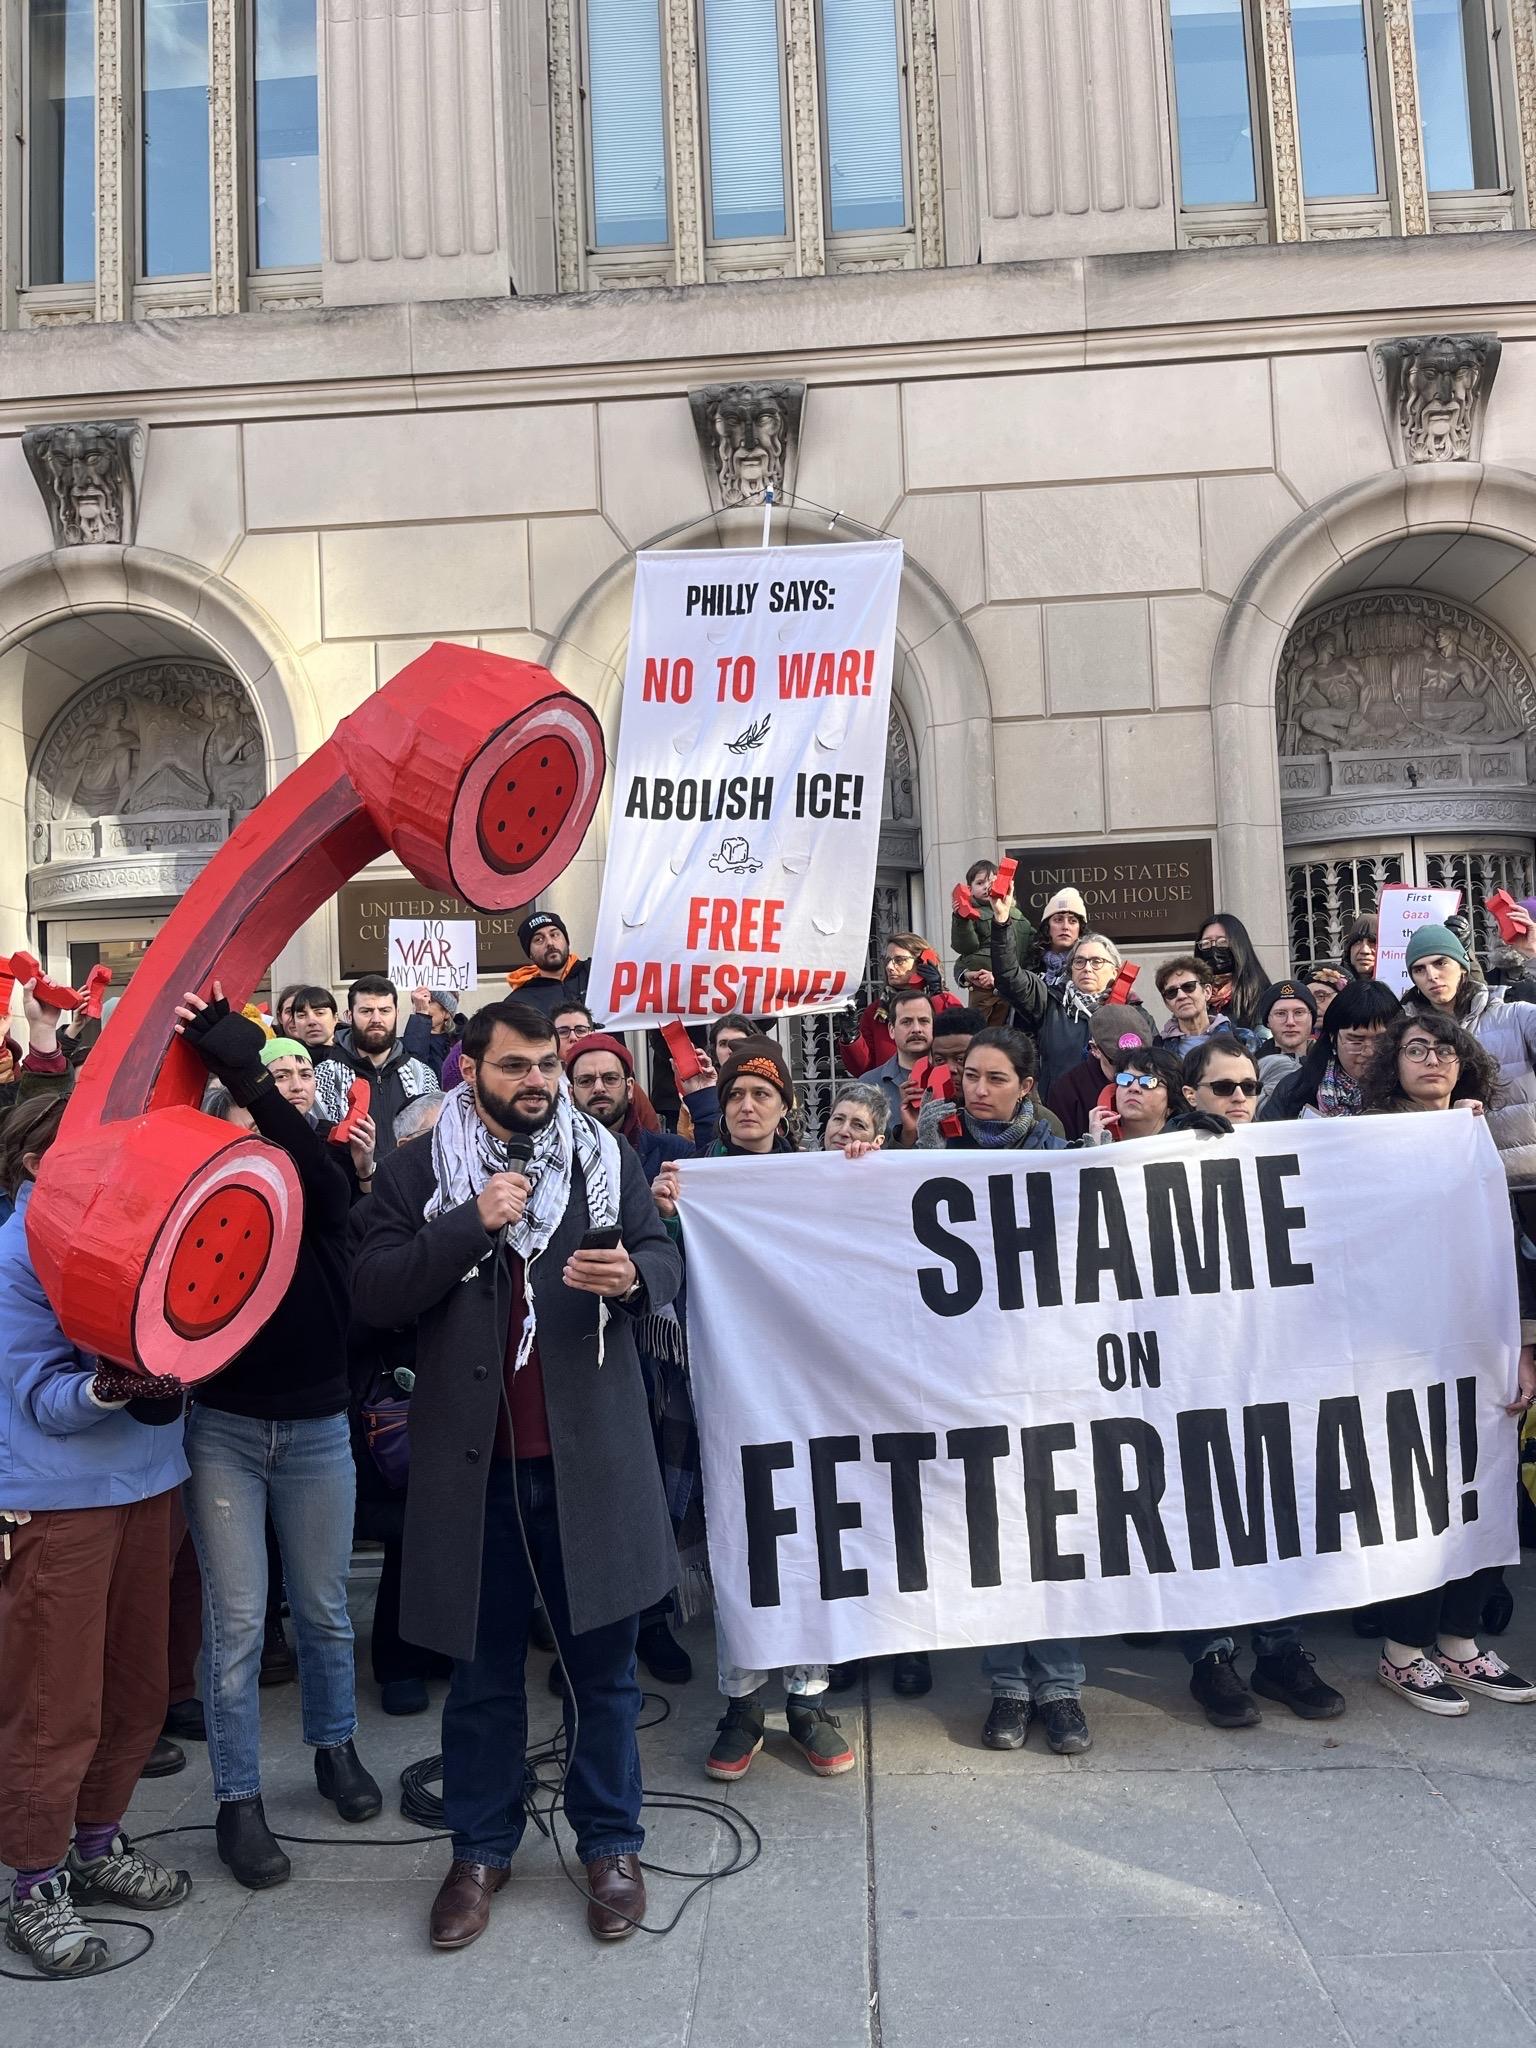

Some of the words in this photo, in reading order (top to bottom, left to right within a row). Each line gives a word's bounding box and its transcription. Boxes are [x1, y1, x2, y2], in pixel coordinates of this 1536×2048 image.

[686, 582, 759, 616] PHILLY
[769, 579, 836, 613] SAYS:
[643, 657, 693, 704] NO
[716, 655, 756, 703] TO
[779, 649, 875, 700] WAR!
[624, 776, 774, 822] ABOLISH
[796, 772, 864, 820] ICE!
[1029, 867, 1108, 886] UNITED
[1114, 862, 1190, 881] STATES
[360, 900, 435, 918] UNITED
[1030, 889, 1117, 908] COM
[1123, 885, 1193, 904] HOUSE
[1406, 893, 1432, 902] First
[477, 919, 515, 935] USE
[686, 896, 785, 953] FREE
[1087, 911, 1129, 921] ESTNUT
[1130, 909, 1169, 919] STREET
[1402, 910, 1430, 919] Gaza
[423, 920, 444, 940] NO
[395, 937, 453, 967] WAR
[389, 962, 470, 991] ANYWHERE!
[608, 961, 847, 1015] PALESTINE!
[912, 1153, 1315, 1318] SHAME
[1096, 1330, 1162, 1392] ON
[740, 1376, 1479, 1608] FETTERMAN!
